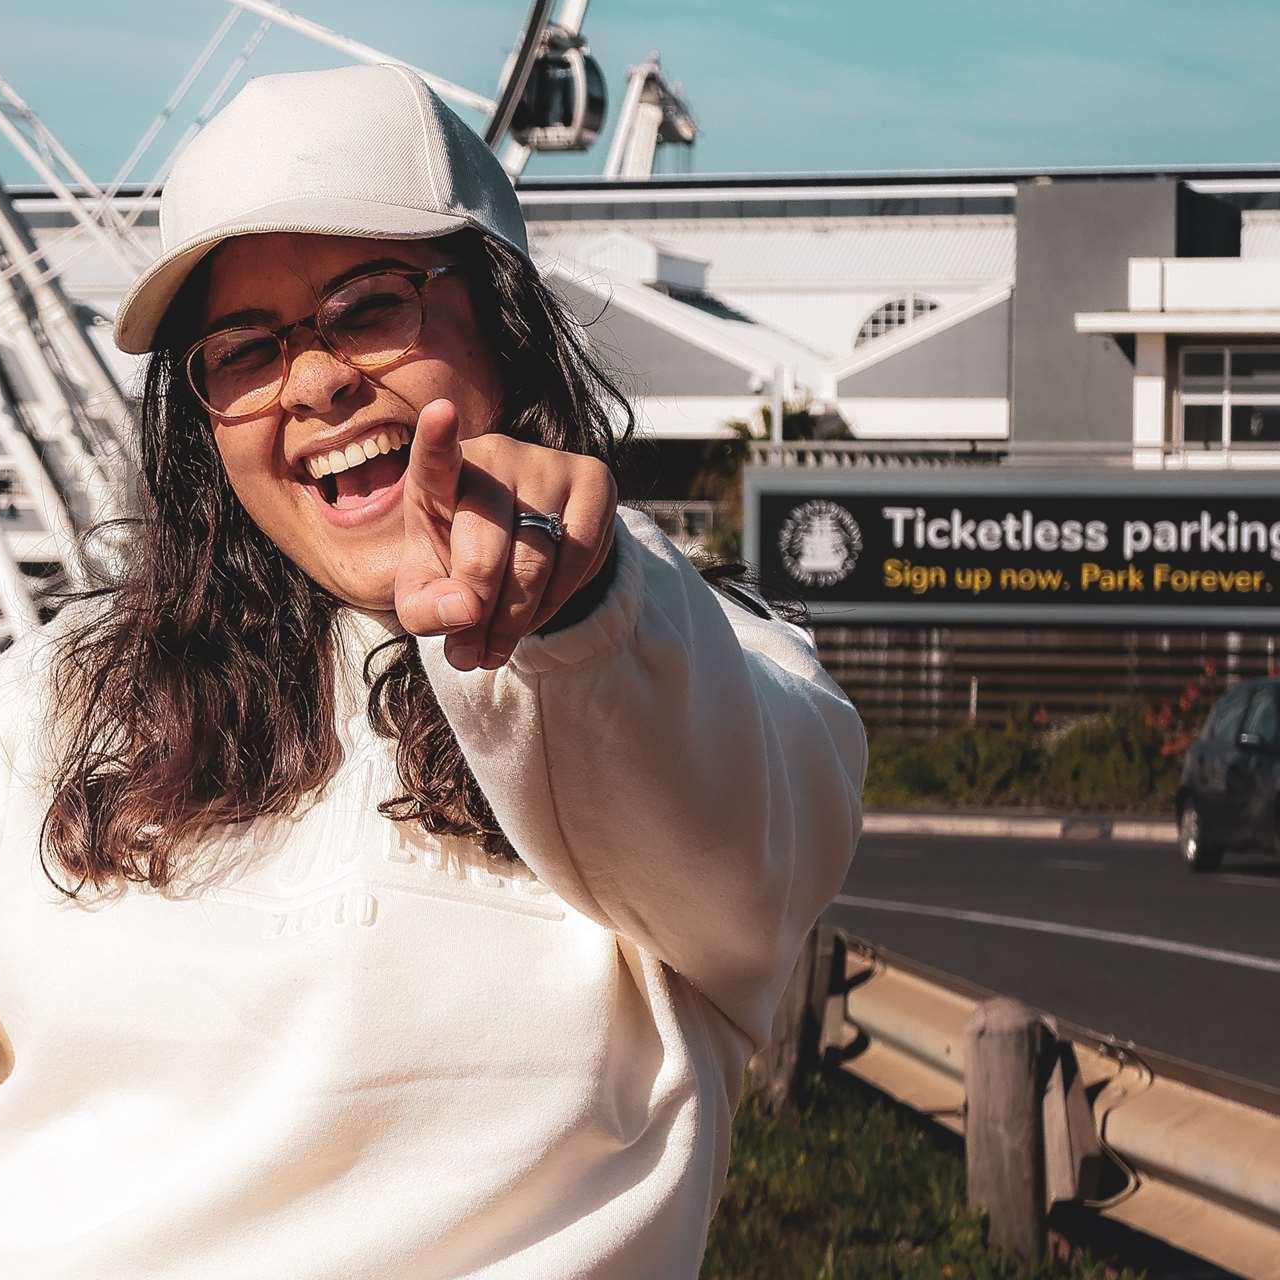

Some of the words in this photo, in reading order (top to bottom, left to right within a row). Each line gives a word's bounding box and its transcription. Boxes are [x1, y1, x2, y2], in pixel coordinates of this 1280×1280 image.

[881, 506, 1109, 552] Ticketless
[883, 558, 947, 595] Sign
[954, 567, 993, 596] up
[999, 567, 1070, 592] now.
[1080, 561, 1145, 592] Park
[1153, 562, 1273, 593] Forever.
